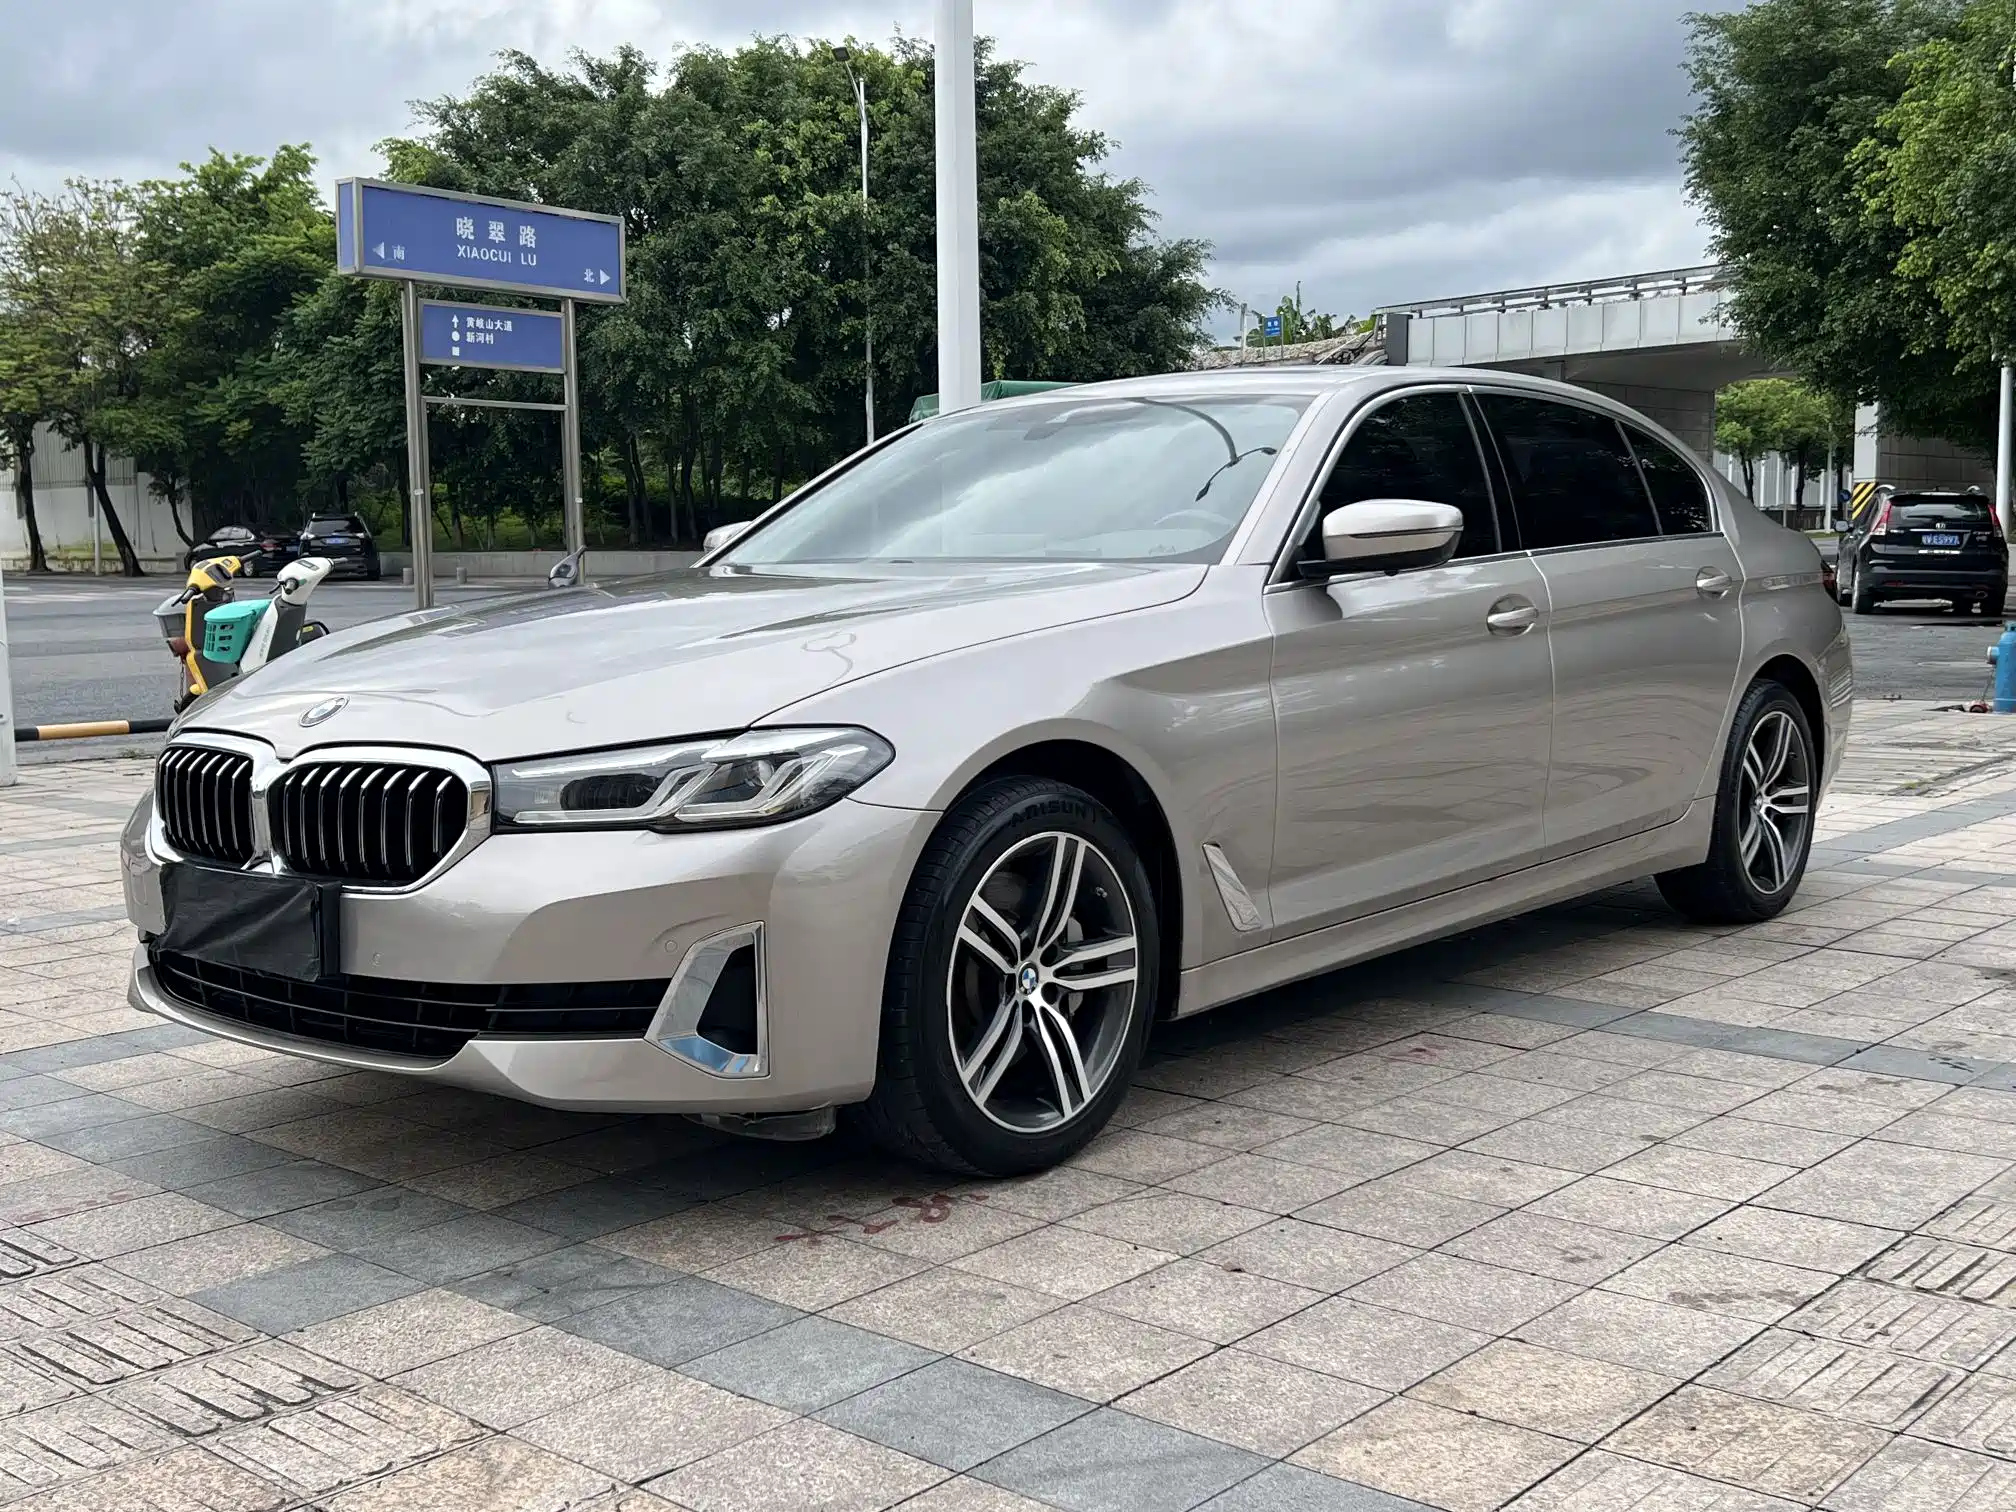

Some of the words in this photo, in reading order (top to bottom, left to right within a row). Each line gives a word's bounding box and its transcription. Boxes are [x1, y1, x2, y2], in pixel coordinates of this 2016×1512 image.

[455, 216, 537, 249] 晓翠路
[392, 244, 405, 261] 南
[456, 243, 512, 264] XIAOCUI
[520, 252, 537, 267] LU
[583, 268, 595, 283] 北
[466, 331, 494, 345] 新河村
